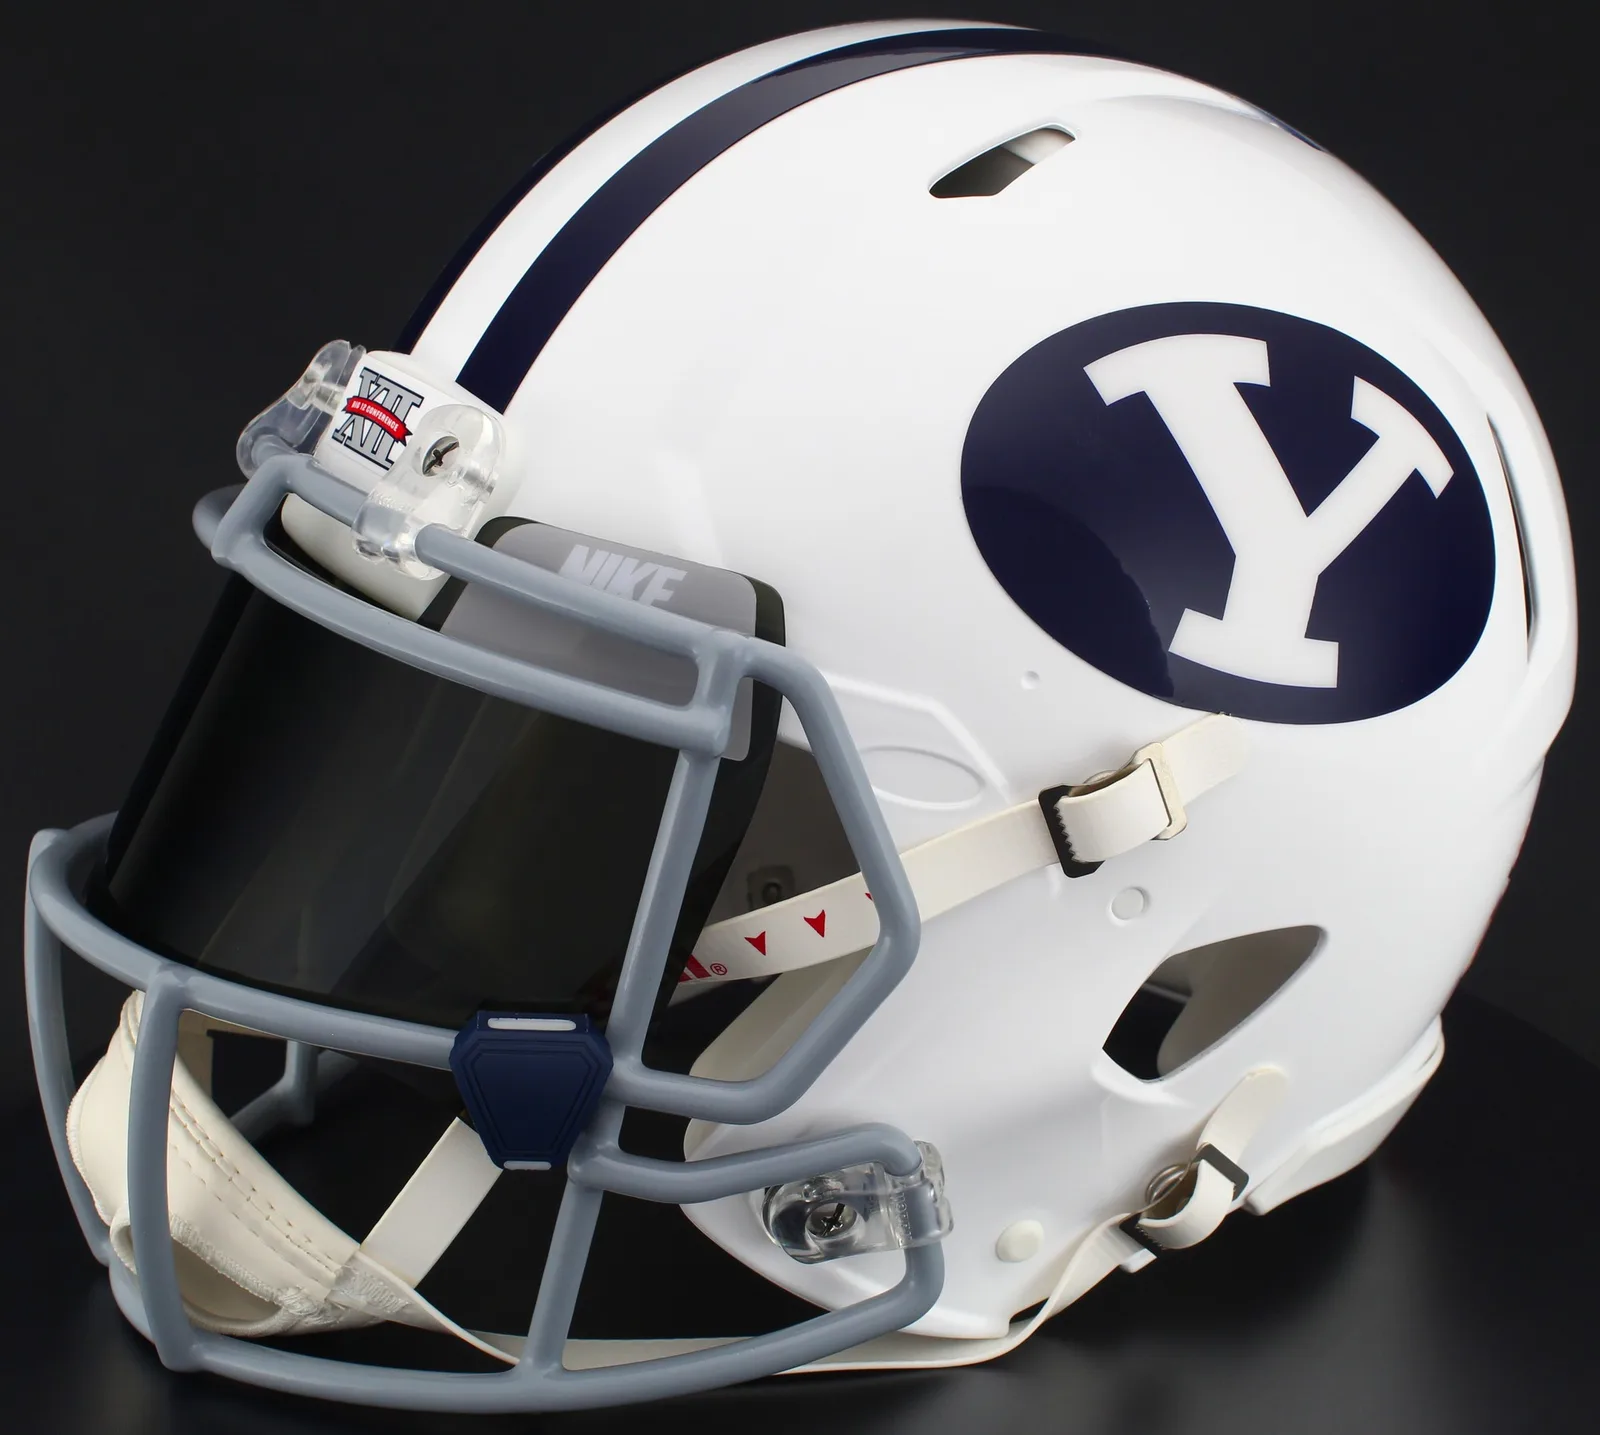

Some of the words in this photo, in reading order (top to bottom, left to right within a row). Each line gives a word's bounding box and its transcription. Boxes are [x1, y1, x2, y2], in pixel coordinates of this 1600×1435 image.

[365, 405, 399, 432] CONFERENCE
[1083, 333, 1454, 688] Y
[558, 544, 688, 606] NIKE
